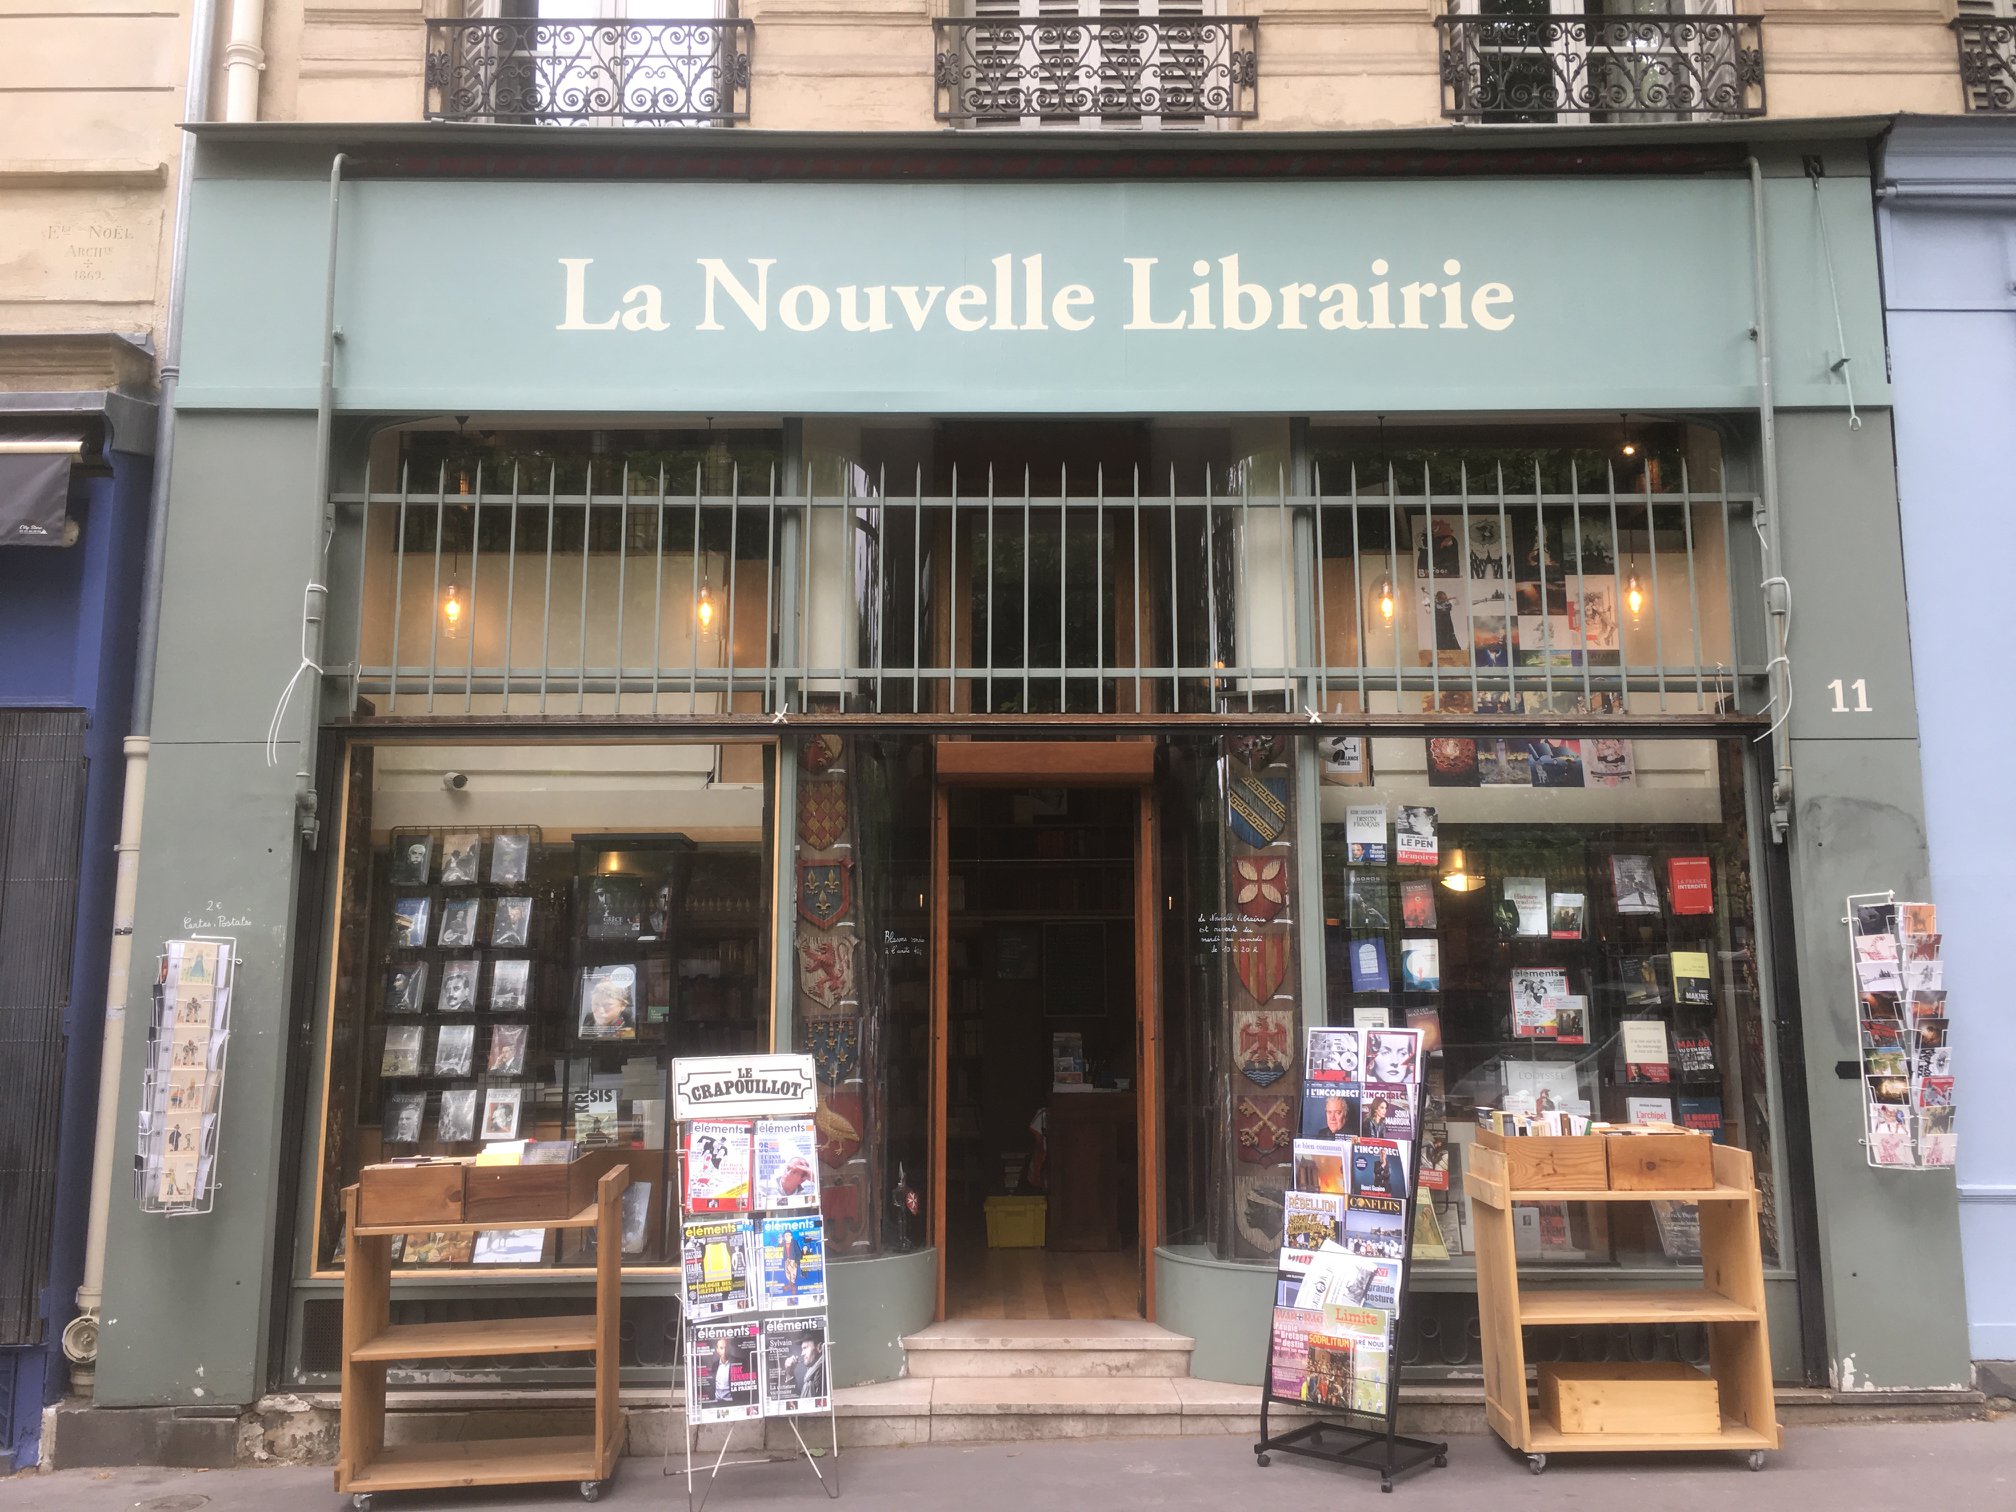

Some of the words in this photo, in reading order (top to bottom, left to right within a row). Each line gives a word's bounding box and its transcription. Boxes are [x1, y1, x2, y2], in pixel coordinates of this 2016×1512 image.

[556, 257, 670, 331] La
[695, 252, 1095, 332] Nouvelle
[1122, 252, 1514, 330] Librairie
[1828, 678, 1873, 712] 11
[1401, 838, 1412, 847] LE
[1414, 839, 1433, 848] PEN
[1397, 851, 1438, 861] Mémoires
[1676, 1040, 1696, 1048] MAI
[1697, 1039, 1712, 1047] 68
[738, 1068, 753, 1079] LE
[691, 1079, 802, 1102] CRAPOUILLOT
[1310, 1088, 1360, 1098] L'INCORRECT
[1636, 1110, 1667, 1120] L'archipel
[759, 1122, 805, 1133] éléments
[1302, 1142, 1315, 1150] bien
[1288, 1194, 1337, 1213] RÉBELLION
[1349, 1197, 1400, 1211] CONFLITS
[685, 1223, 737, 1238] éléments
[765, 1219, 815, 1231] éléments
[1335, 1307, 1377, 1325] Limite
[766, 1319, 818, 1332] éléments
[698, 1326, 750, 1339] éléments
[769, 1339, 793, 1347] Sylvain
[1367, 1340, 1385, 1348] NOUS
